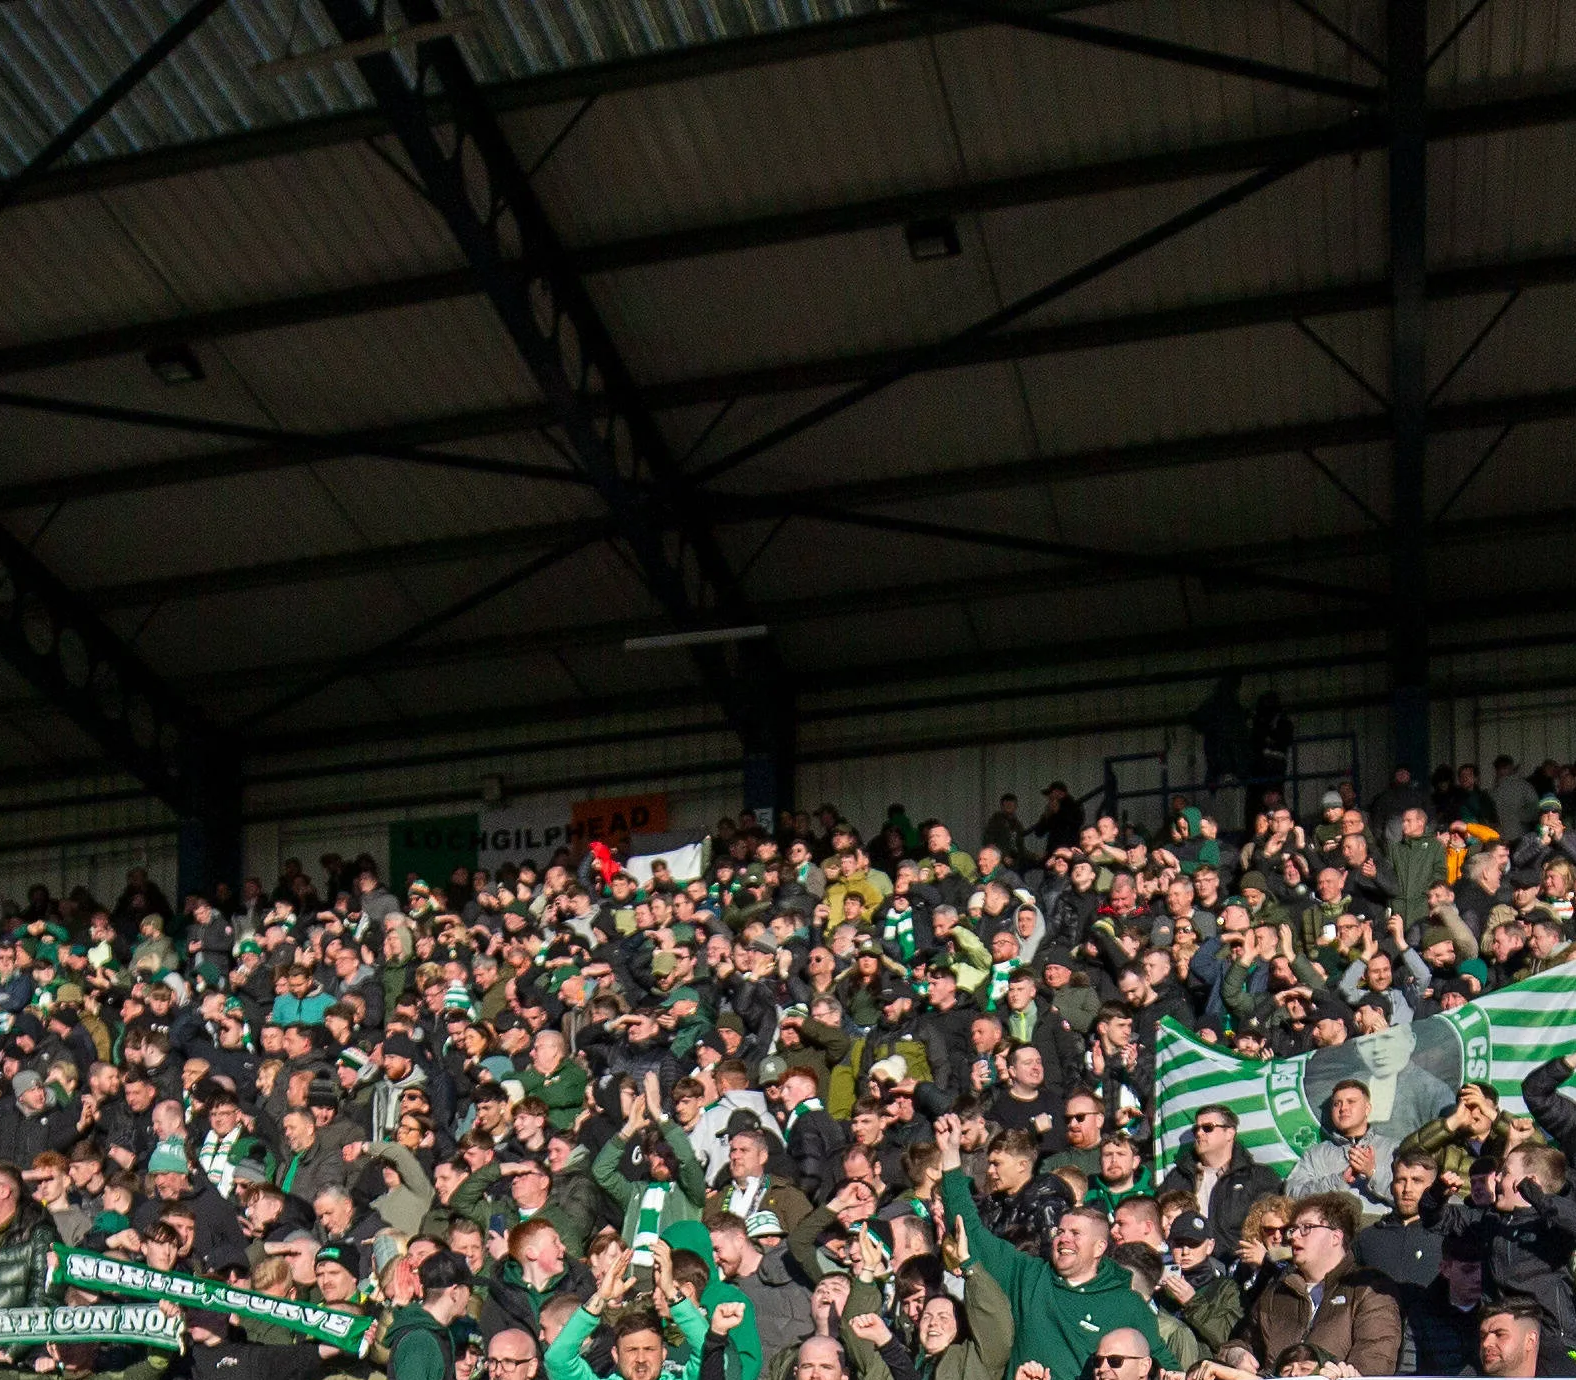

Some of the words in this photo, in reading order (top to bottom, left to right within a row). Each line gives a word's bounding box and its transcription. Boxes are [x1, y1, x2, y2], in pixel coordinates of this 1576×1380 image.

[405, 806, 650, 850] LOCHGILPHEAD
[67, 1254, 196, 1296] NORTH
[224, 1290, 355, 1337] CURVE
[55, 1306, 119, 1334] CON
